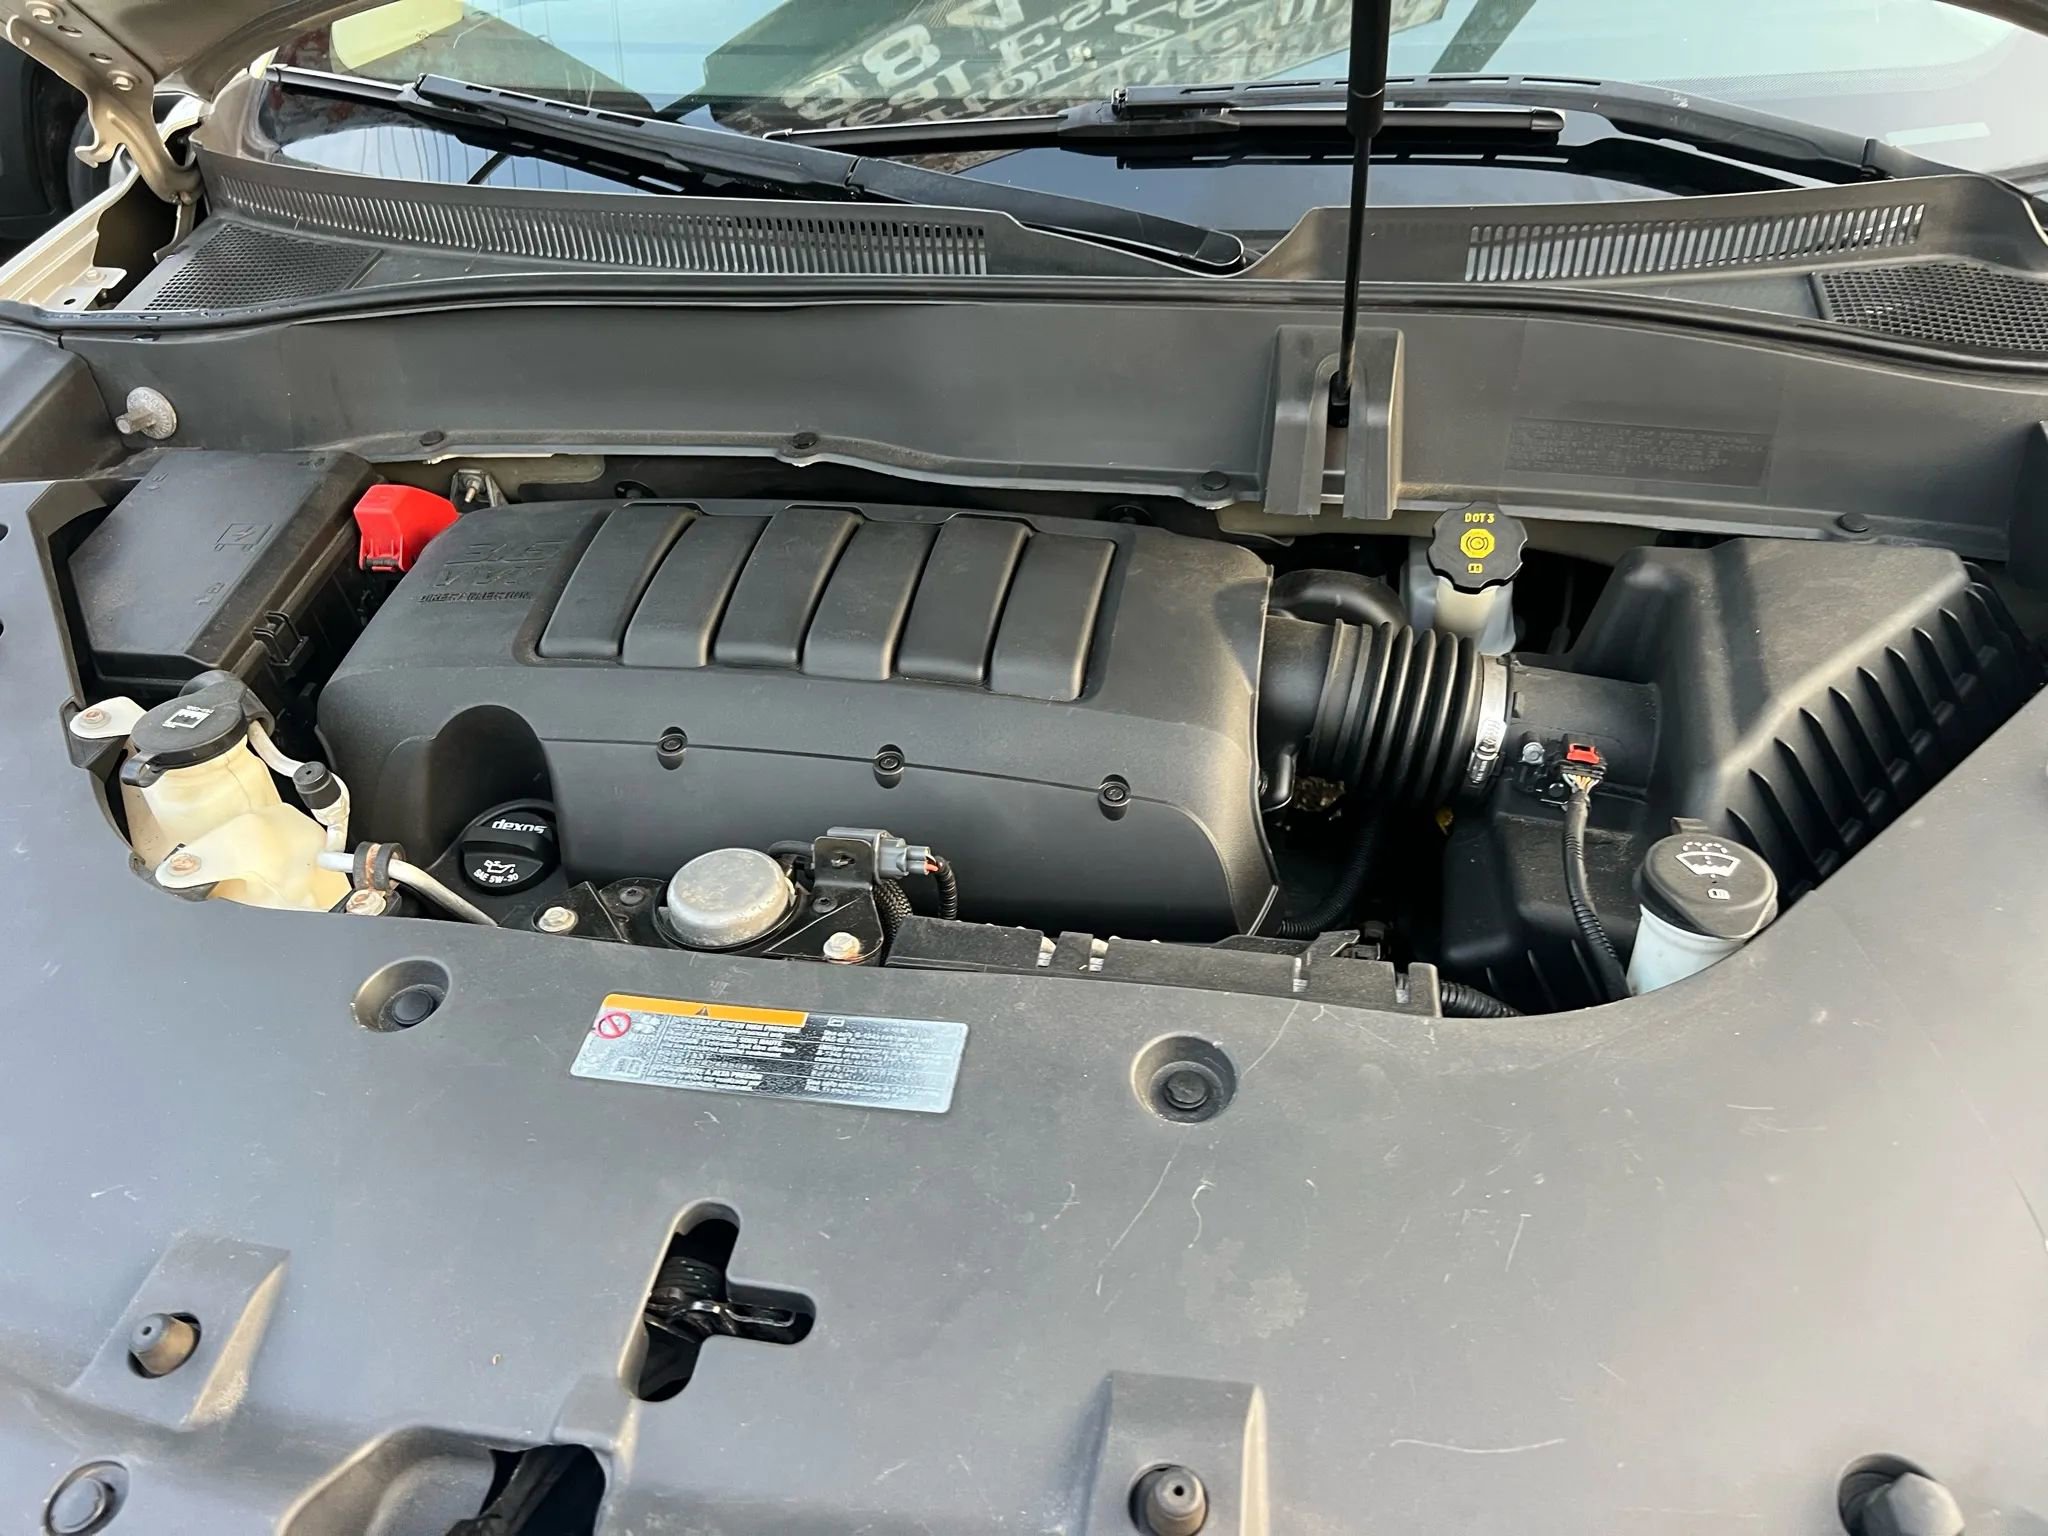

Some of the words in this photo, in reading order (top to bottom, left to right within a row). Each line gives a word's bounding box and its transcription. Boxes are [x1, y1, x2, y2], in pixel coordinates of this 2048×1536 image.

[1464, 512, 1485, 523] DOT
[1486, 513, 1495, 524] 3
[473, 868, 490, 882] SAE
[488, 872, 519, 884] 5W-30
